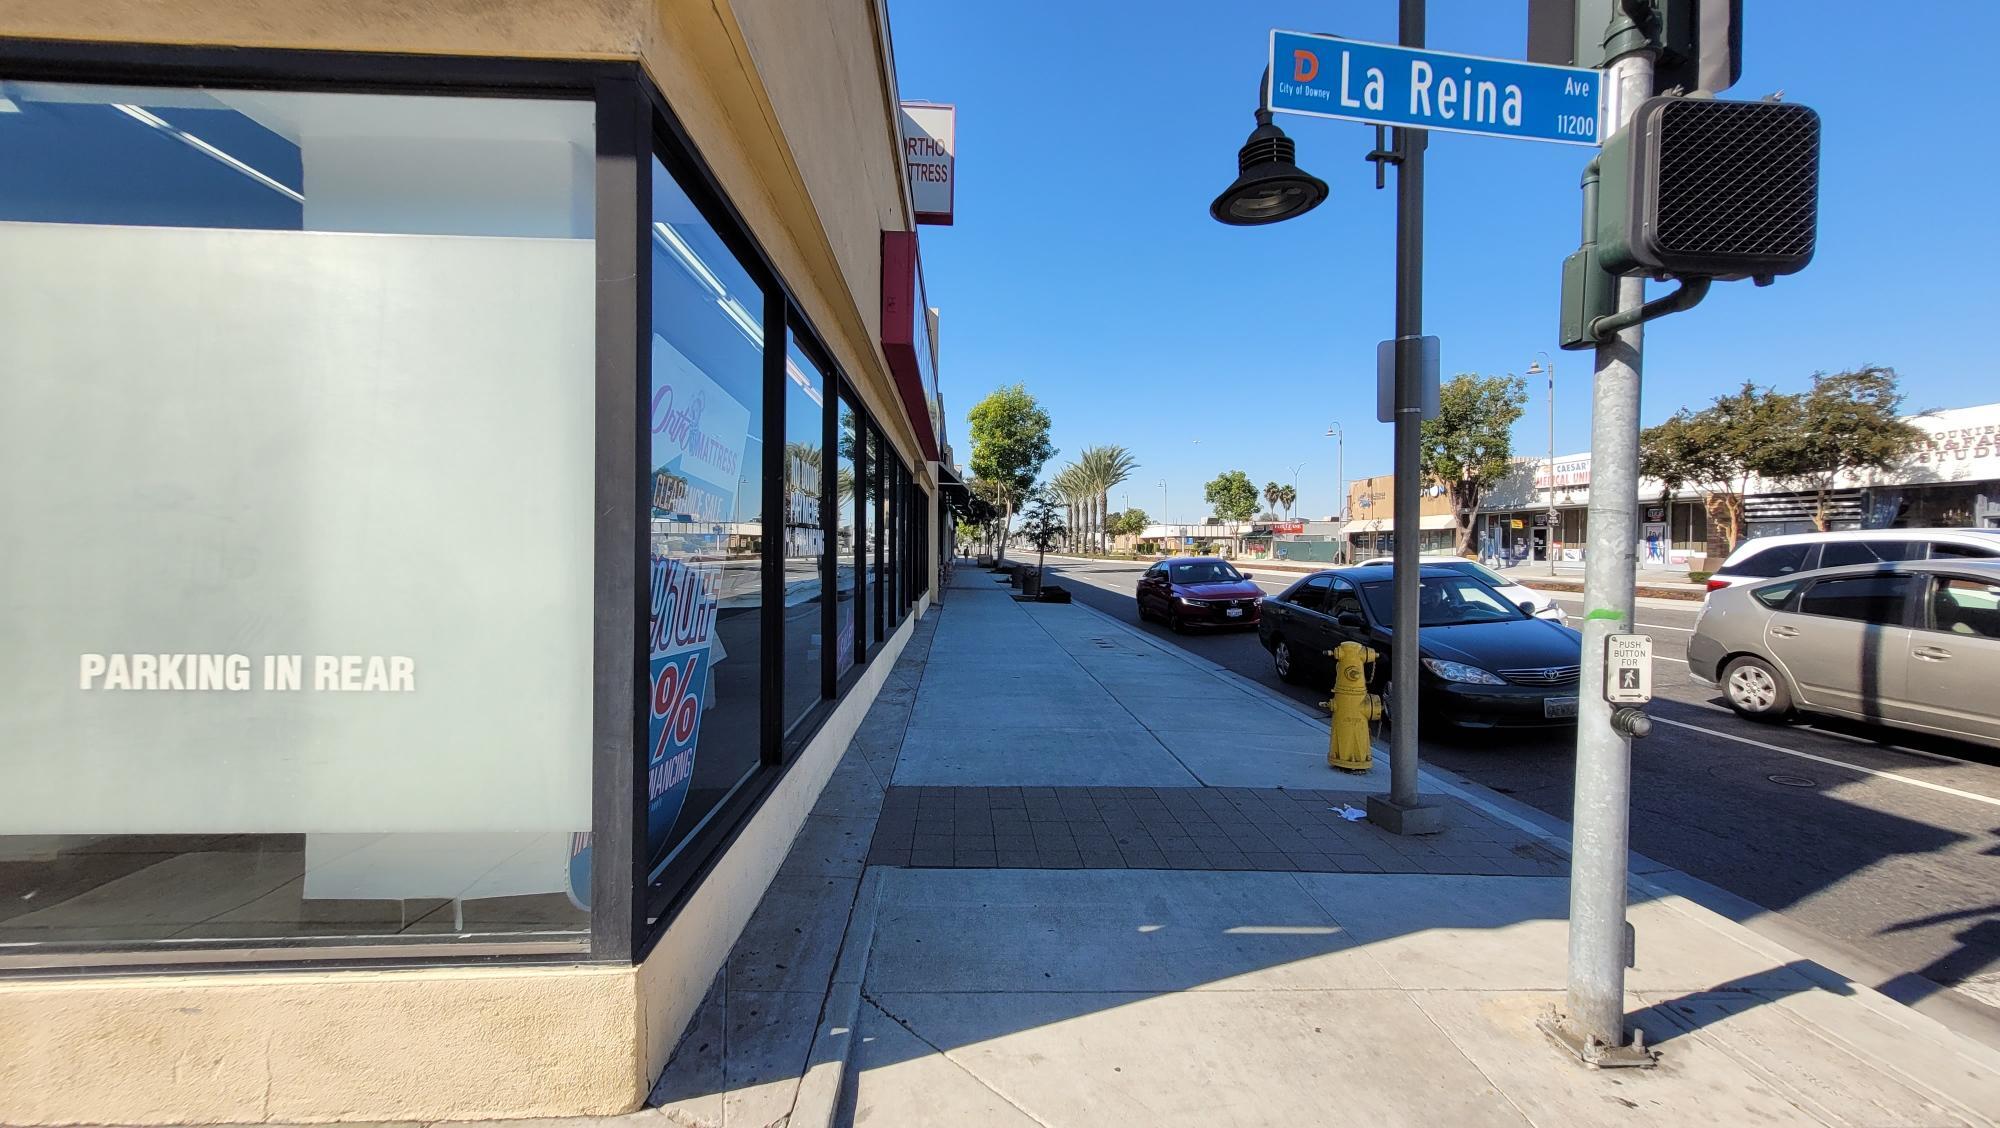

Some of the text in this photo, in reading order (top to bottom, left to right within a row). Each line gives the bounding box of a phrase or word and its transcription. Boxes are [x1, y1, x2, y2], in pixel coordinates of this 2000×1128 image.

[1279, 81, 1331, 101] City of Downey
[1340, 50, 1523, 128] La Reina
[1564, 76, 1590, 97] Ave
[1557, 114, 1594, 137] 11200
[908, 162, 948, 183] TTRESS
[1556, 460, 1590, 473] CAESAR'
[1613, 649, 1647, 658] BUTTON
[1619, 641, 1642, 649] PUSH
[79, 653, 416, 692] PARKING IN REAR
[1621, 658, 1638, 667] FOR
